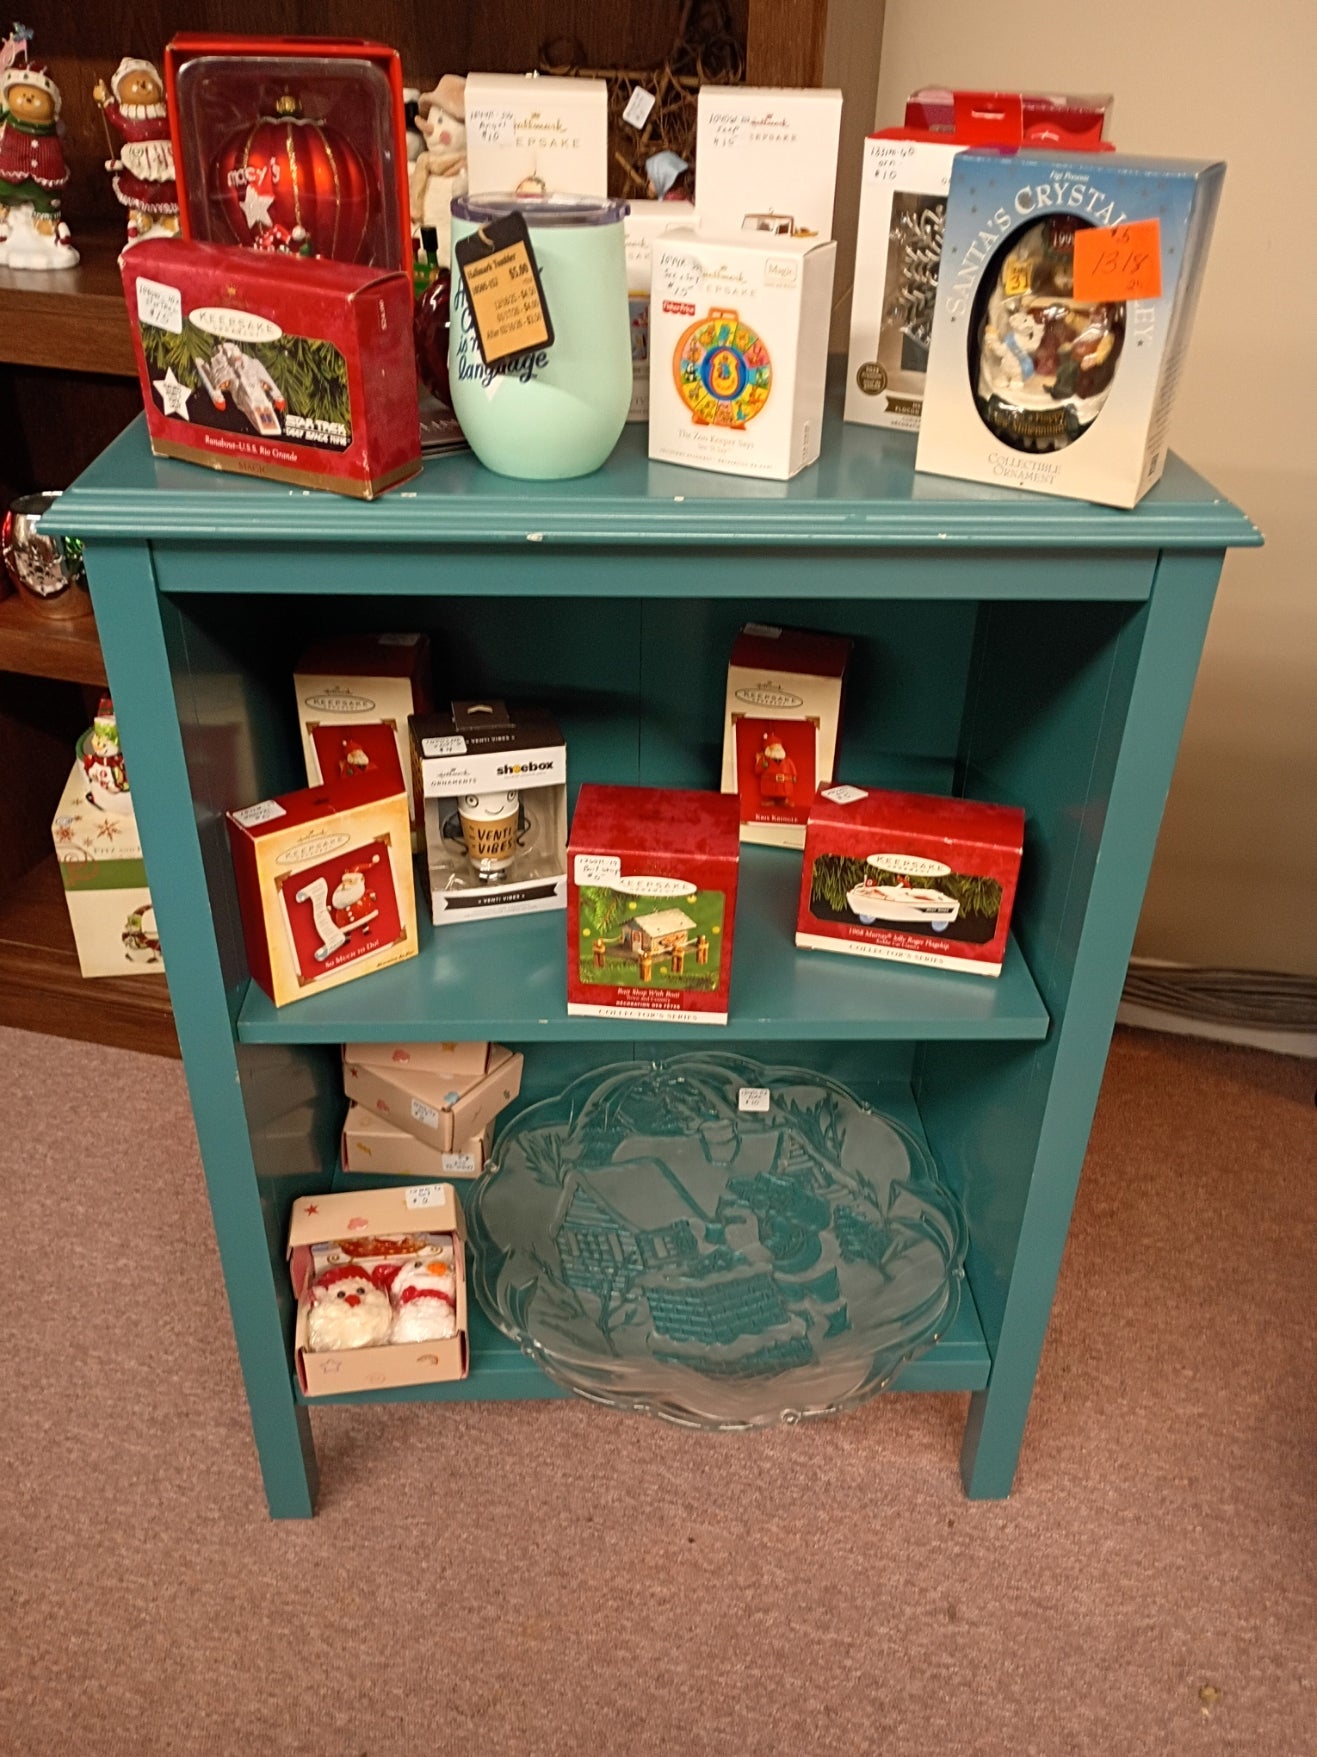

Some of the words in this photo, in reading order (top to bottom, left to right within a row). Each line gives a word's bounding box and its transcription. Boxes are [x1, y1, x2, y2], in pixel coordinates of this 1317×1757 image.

[514, 137, 581, 149] EPSAKE
[227, 157, 281, 188] macy's
[1052, 233, 1076, 248] 199
[945, 207, 1011, 316] SANTA'S
[198, 311, 274, 333] KEEPSAKE
[285, 414, 315, 432] STAR
[314, 419, 347, 437] TREK
[259, 446, 272, 457] Rio
[271, 448, 298, 462] Grande
[988, 452, 1061, 475] COLLECTIBLE
[993, 464, 1055, 485] ORNAMENT
[743, 690, 796, 704] KEEPSAKE
[496, 761, 555, 776] shoebox
[477, 827, 512, 842] VENTI
[285, 836, 345, 859] KEEPSAKE
[478, 839, 513, 855] VIBES
[876, 855, 944, 873] KEEPSAKE
[598, 1008, 664, 1019] COLLECTOR'S
[665, 1012, 699, 1022] SERIES
